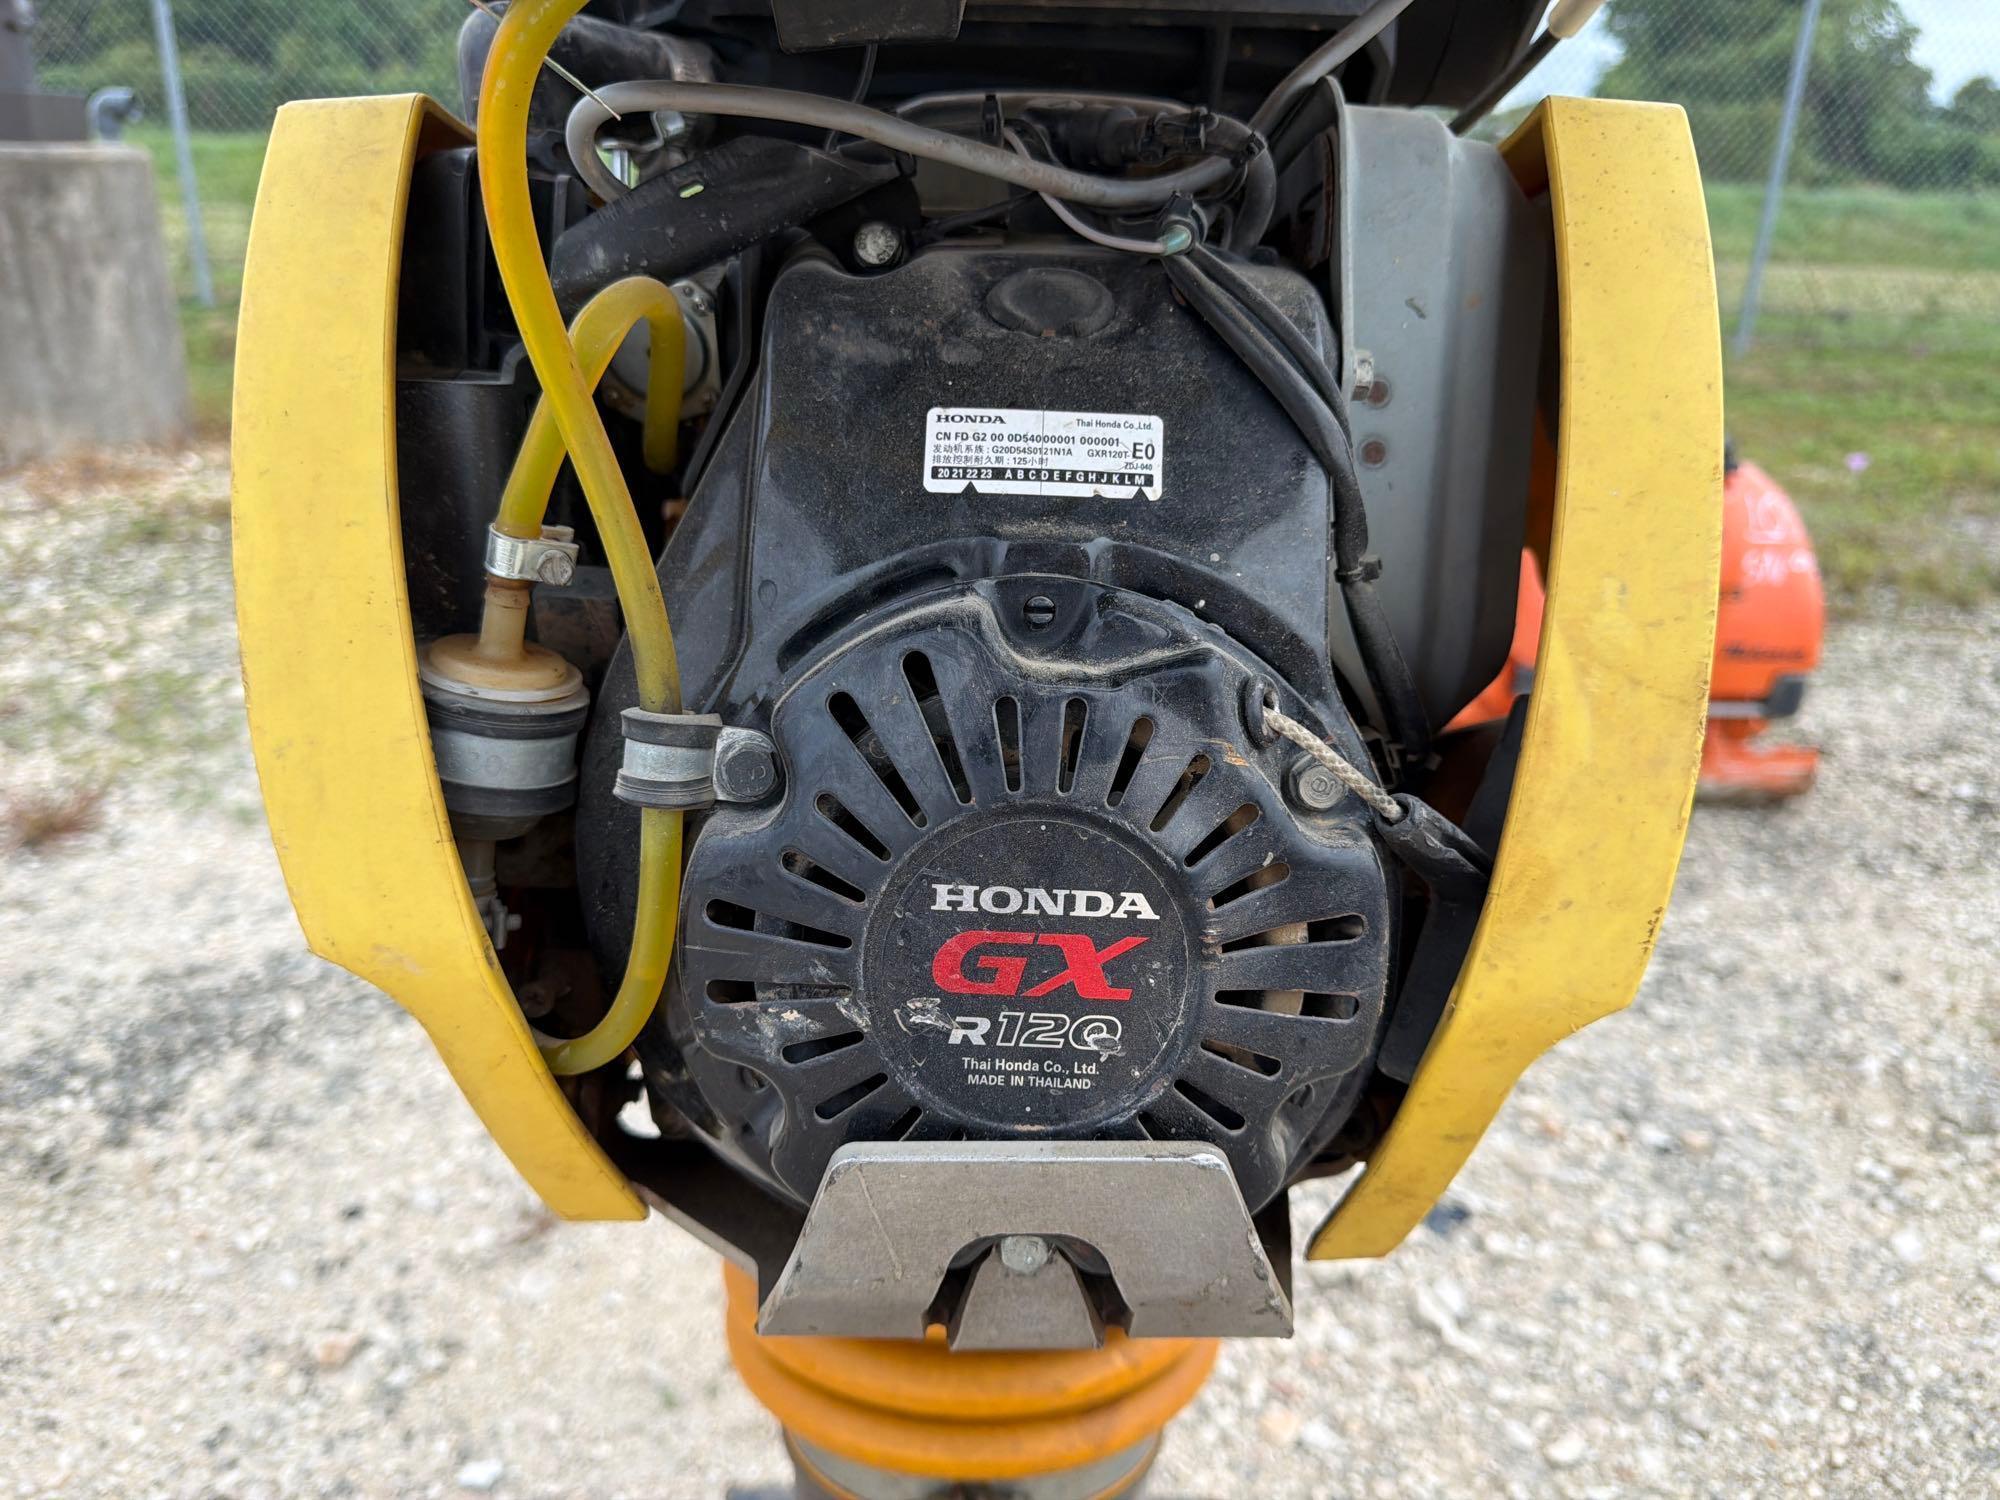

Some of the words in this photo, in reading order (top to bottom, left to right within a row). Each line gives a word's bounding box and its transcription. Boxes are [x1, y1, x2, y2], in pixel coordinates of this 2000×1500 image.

[936, 415, 1007, 424] HONDA
[1076, 419, 1093, 427] Thai
[1095, 420, 1121, 429] Honda
[936, 432, 951, 441] CN
[955, 432, 969, 441] FD
[972, 432, 987, 442] G2
[990, 433, 1004, 442] 00
[1080, 436, 1120, 447] 000001
[1132, 442, 1155, 460] E0
[937, 468, 950, 478] 20
[952, 468, 963, 478] 21
[966, 469, 978, 478] 22
[980, 469, 992, 479] 23
[930, 884, 1160, 920] HONDA
[932, 930, 1150, 1000] GX
[962, 1057, 990, 1070] Thai
[995, 1059, 1039, 1072] Honda
[1044, 1060, 1069, 1075] Co.,
[1074, 1061, 1099, 1075] Ltd.
[968, 1075, 1005, 1086] MADE
[1011, 1075, 1024, 1086] IN
[1028, 1076, 1091, 1089] THAILAND
